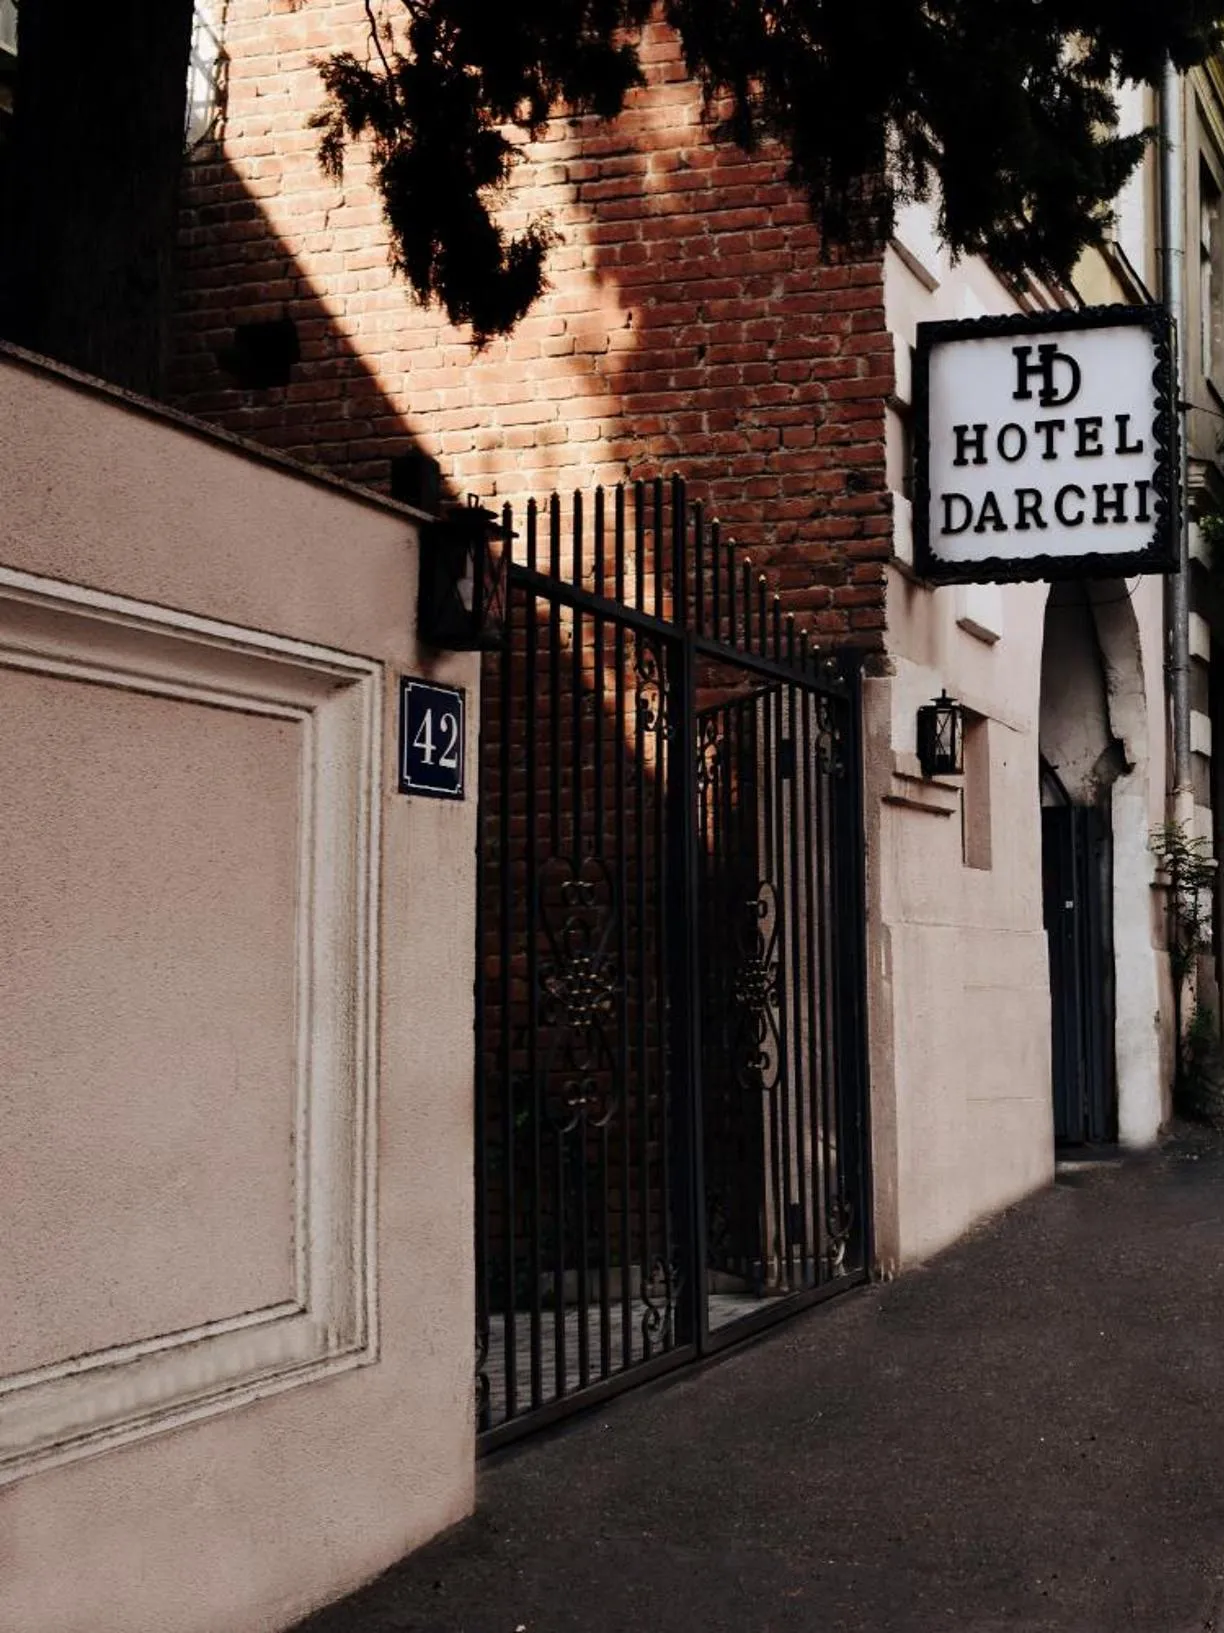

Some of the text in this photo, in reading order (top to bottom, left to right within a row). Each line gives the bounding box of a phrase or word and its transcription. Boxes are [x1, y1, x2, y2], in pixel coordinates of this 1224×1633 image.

[1012, 343, 1081, 407] HD
[952, 414, 1144, 466] HOTEL
[940, 480, 1151, 535] DARCHI
[412, 708, 458, 768] 42
